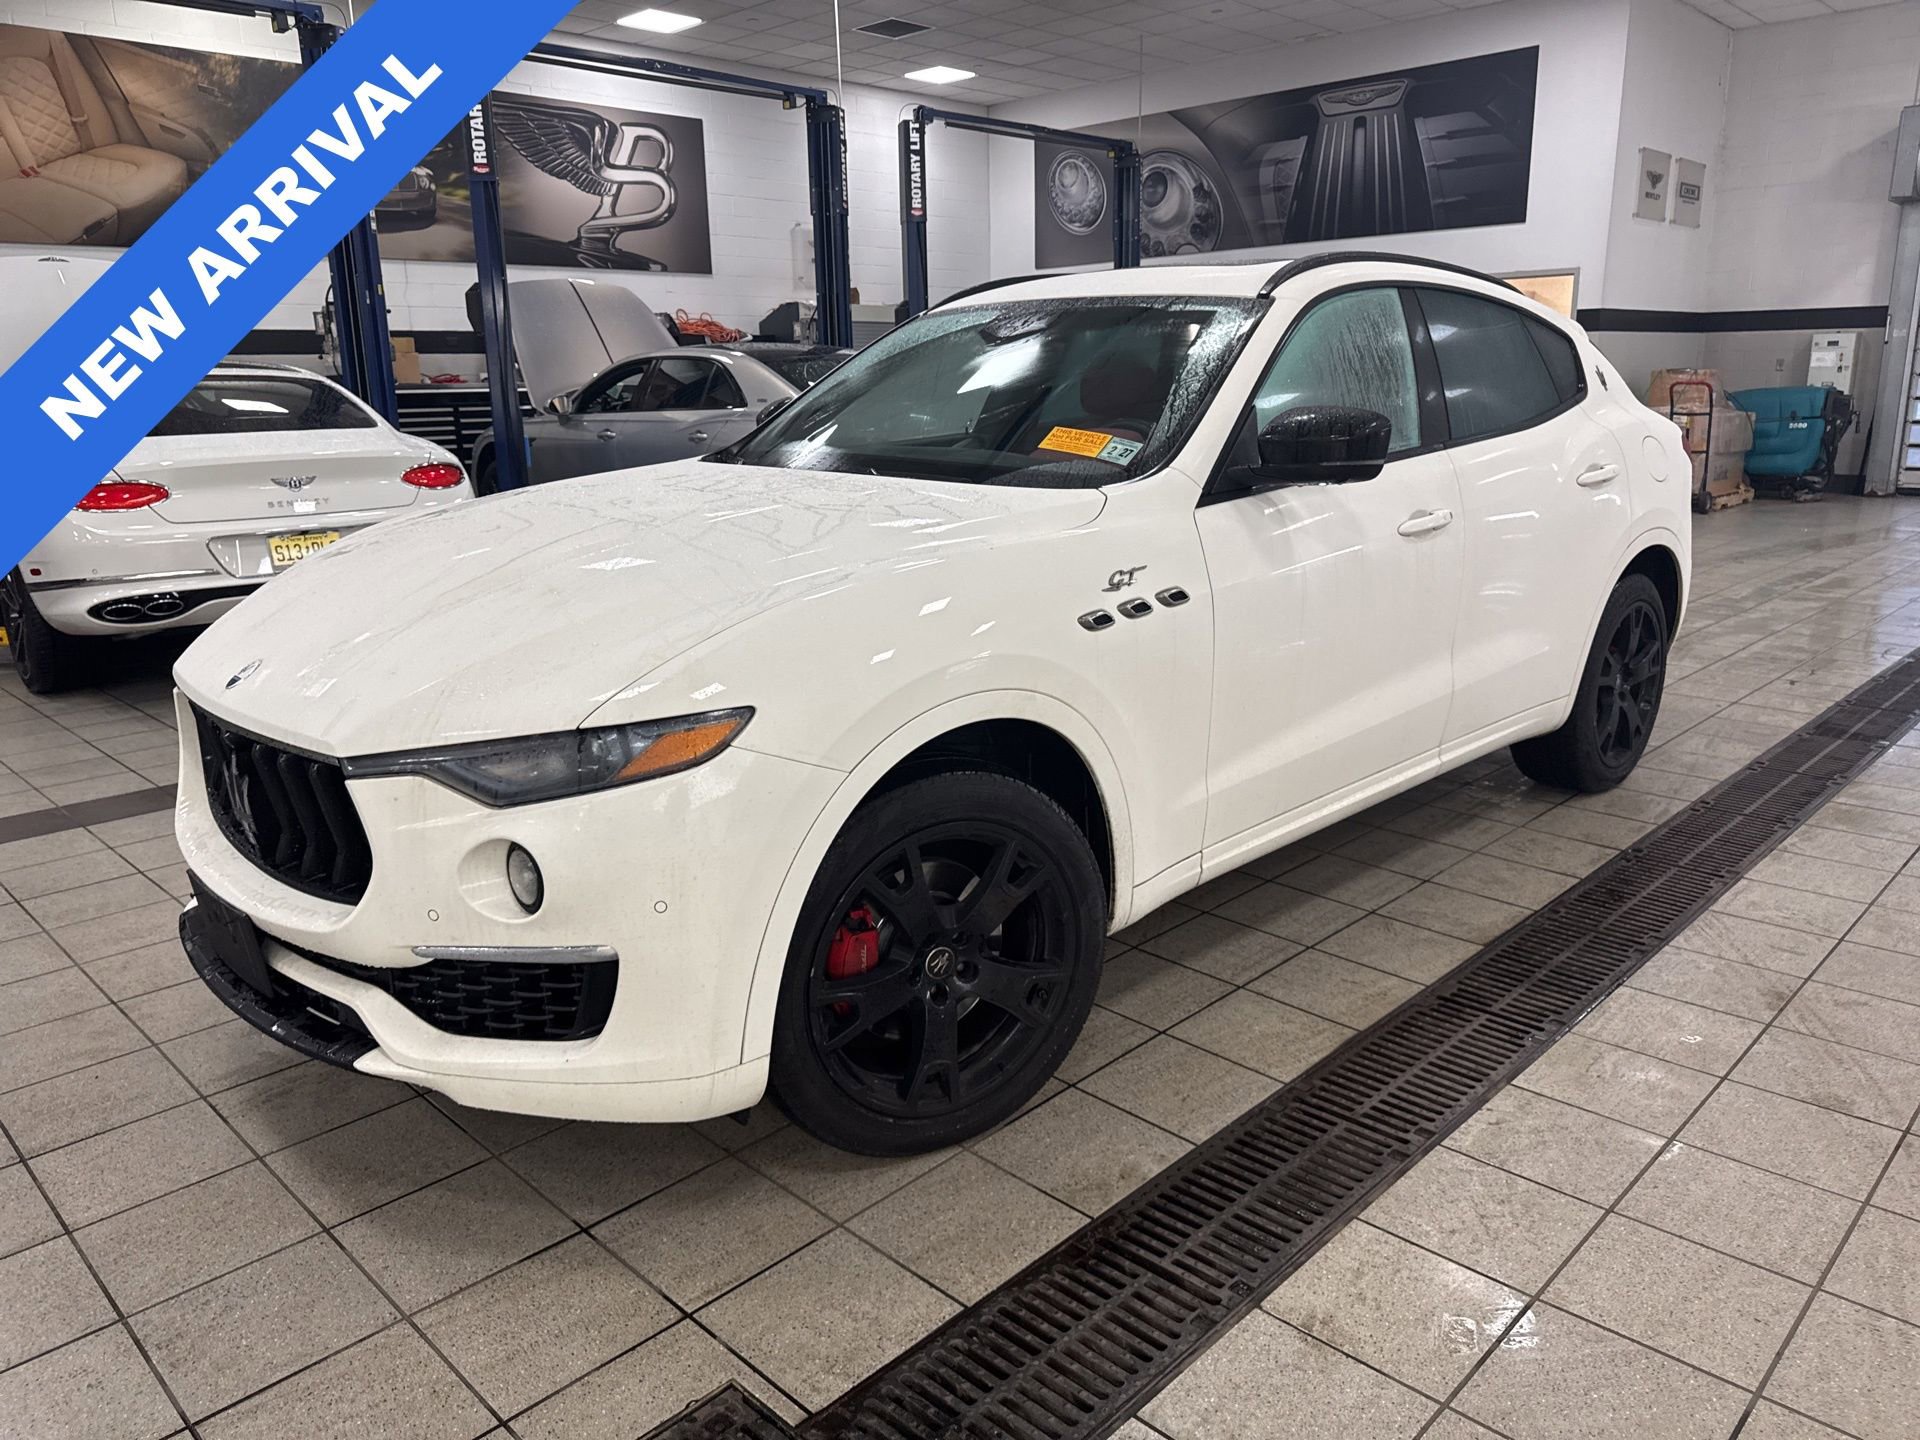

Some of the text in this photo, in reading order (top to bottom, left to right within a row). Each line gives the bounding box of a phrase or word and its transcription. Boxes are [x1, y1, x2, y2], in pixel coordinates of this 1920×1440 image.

[469, 104, 487, 163] ROTAR
[909, 121, 922, 208] ROTARY LIFT
[1074, 430, 1108, 440] VEHICLE
[1084, 437, 1105, 445] SALE
[1107, 446, 1118, 455] 2
[1118, 447, 1134, 458] 27
[267, 498, 329, 509] BENEY
[1101, 565, 1148, 592] GT
